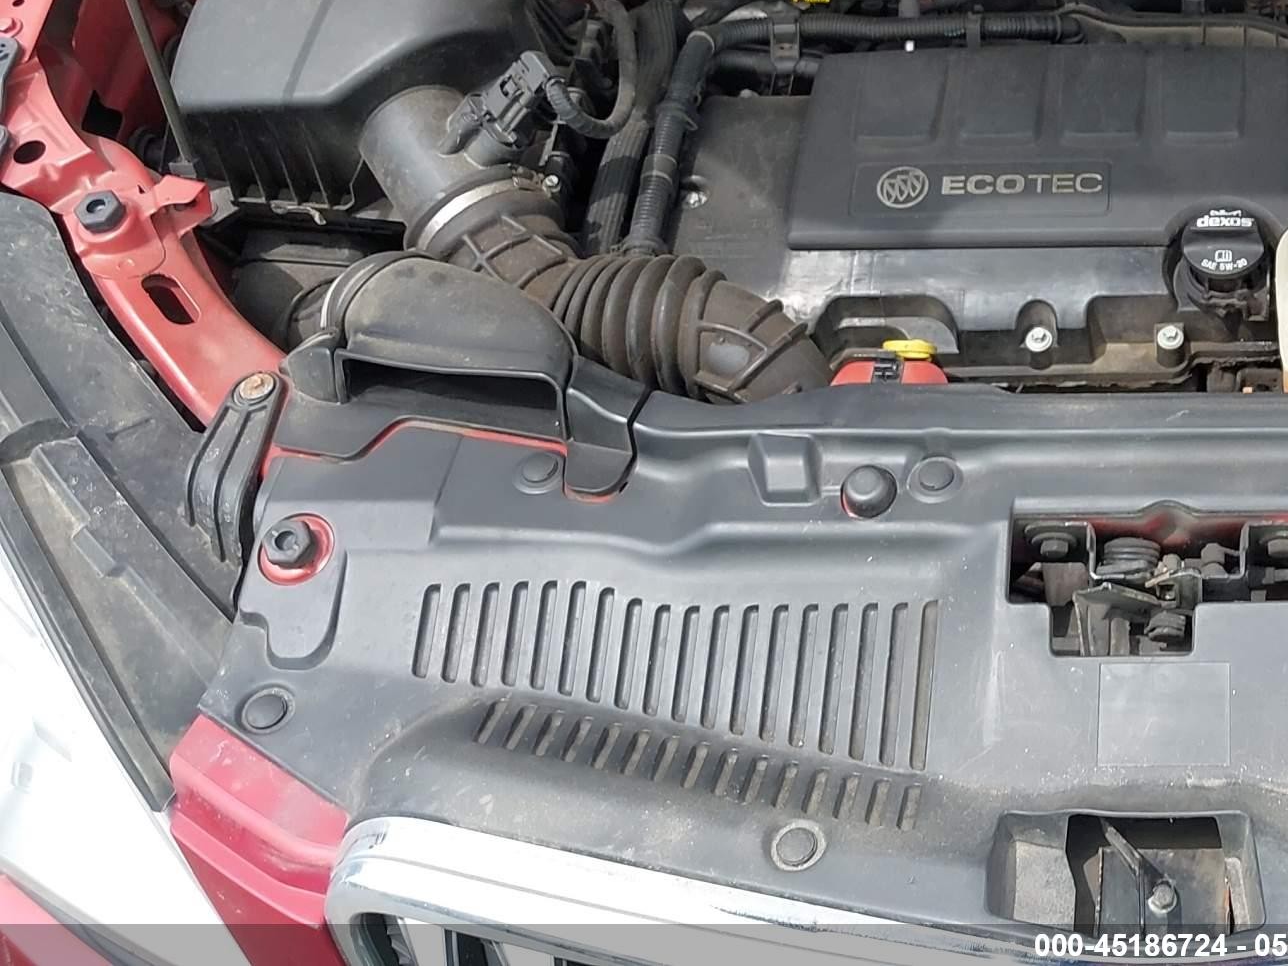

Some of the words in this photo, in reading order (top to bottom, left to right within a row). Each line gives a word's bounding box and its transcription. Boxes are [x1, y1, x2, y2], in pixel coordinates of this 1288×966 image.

[941, 172, 1103, 195] ECOTEC
[1196, 214, 1254, 228] dexos
[1201, 258, 1218, 271] SAE
